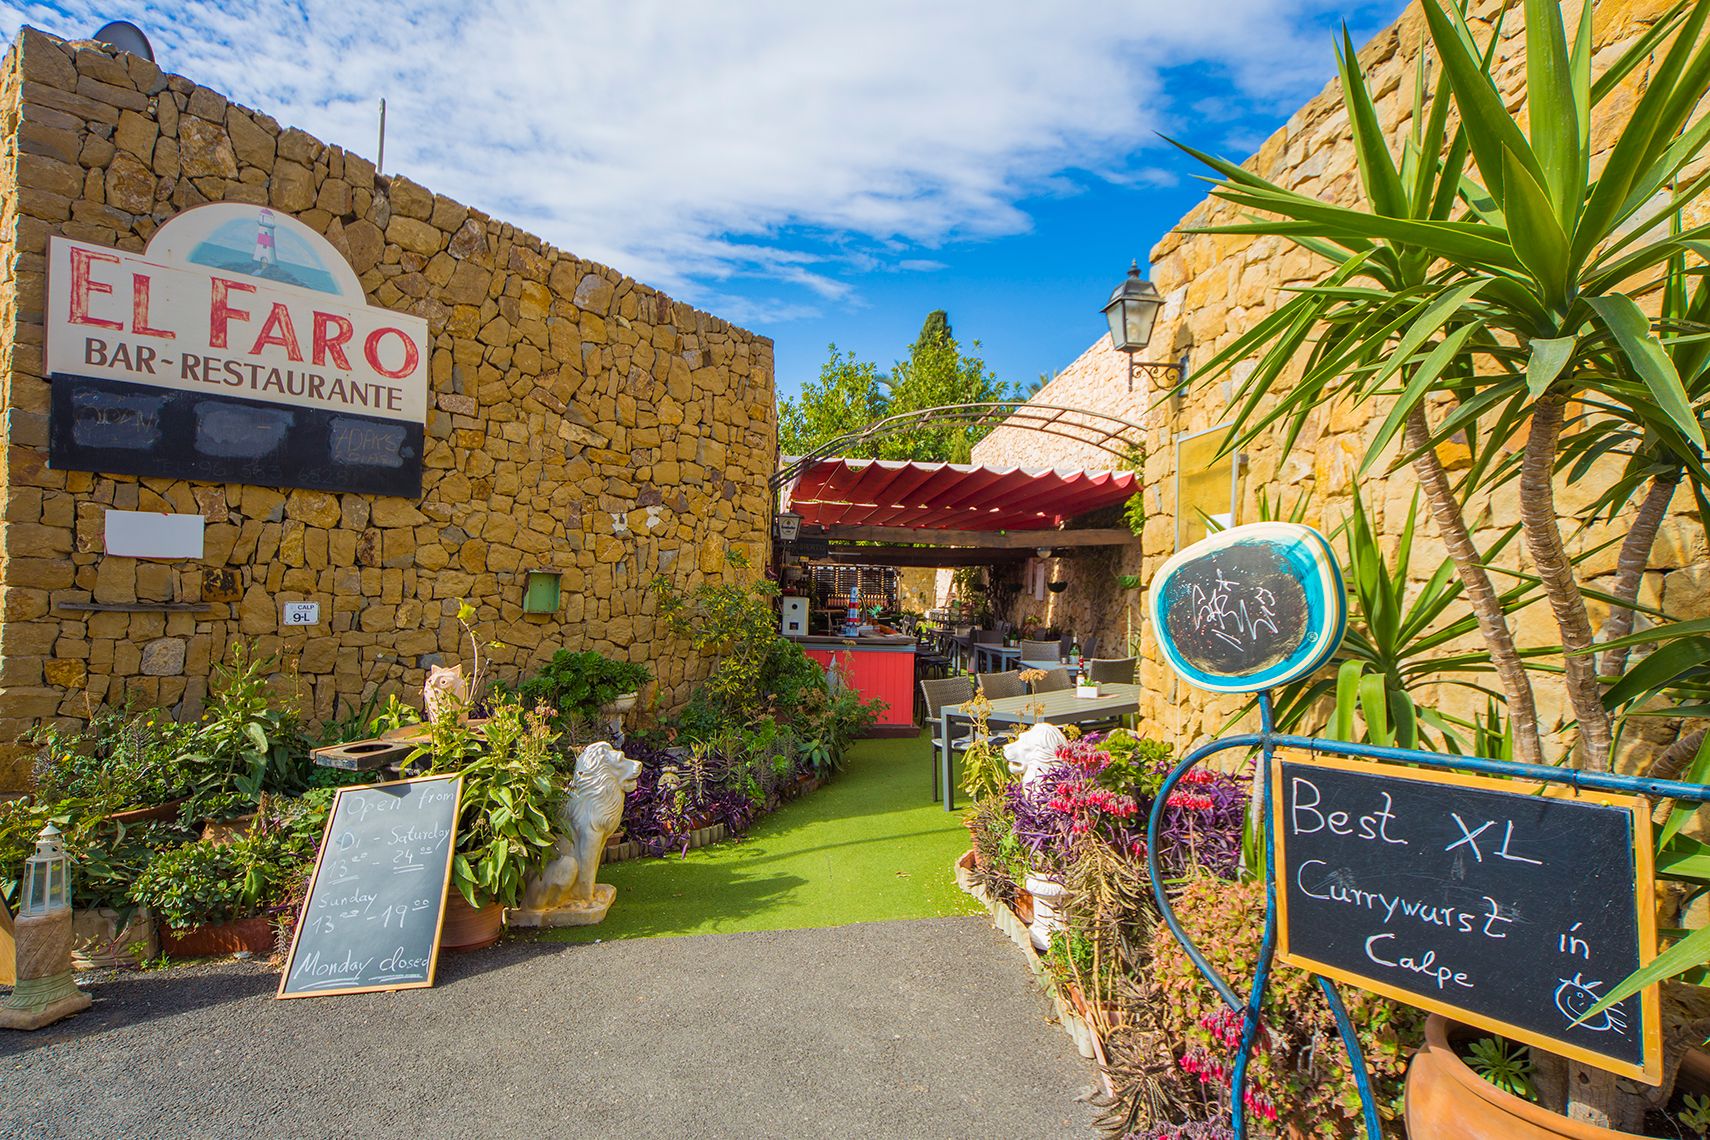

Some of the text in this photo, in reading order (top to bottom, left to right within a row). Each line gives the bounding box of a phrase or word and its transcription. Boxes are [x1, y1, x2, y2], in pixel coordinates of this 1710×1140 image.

[67, 245, 420, 380] EL FARO
[347, 785, 454, 822] Open from
[1292, 777, 1544, 865] Best XL
[387, 821, 450, 851] Saturday
[318, 887, 378, 915] Sunday
[1297, 859, 1590, 960] Currywurst in
[293, 945, 432, 980] Monday closed
[1364, 933, 1475, 990] Calpe
